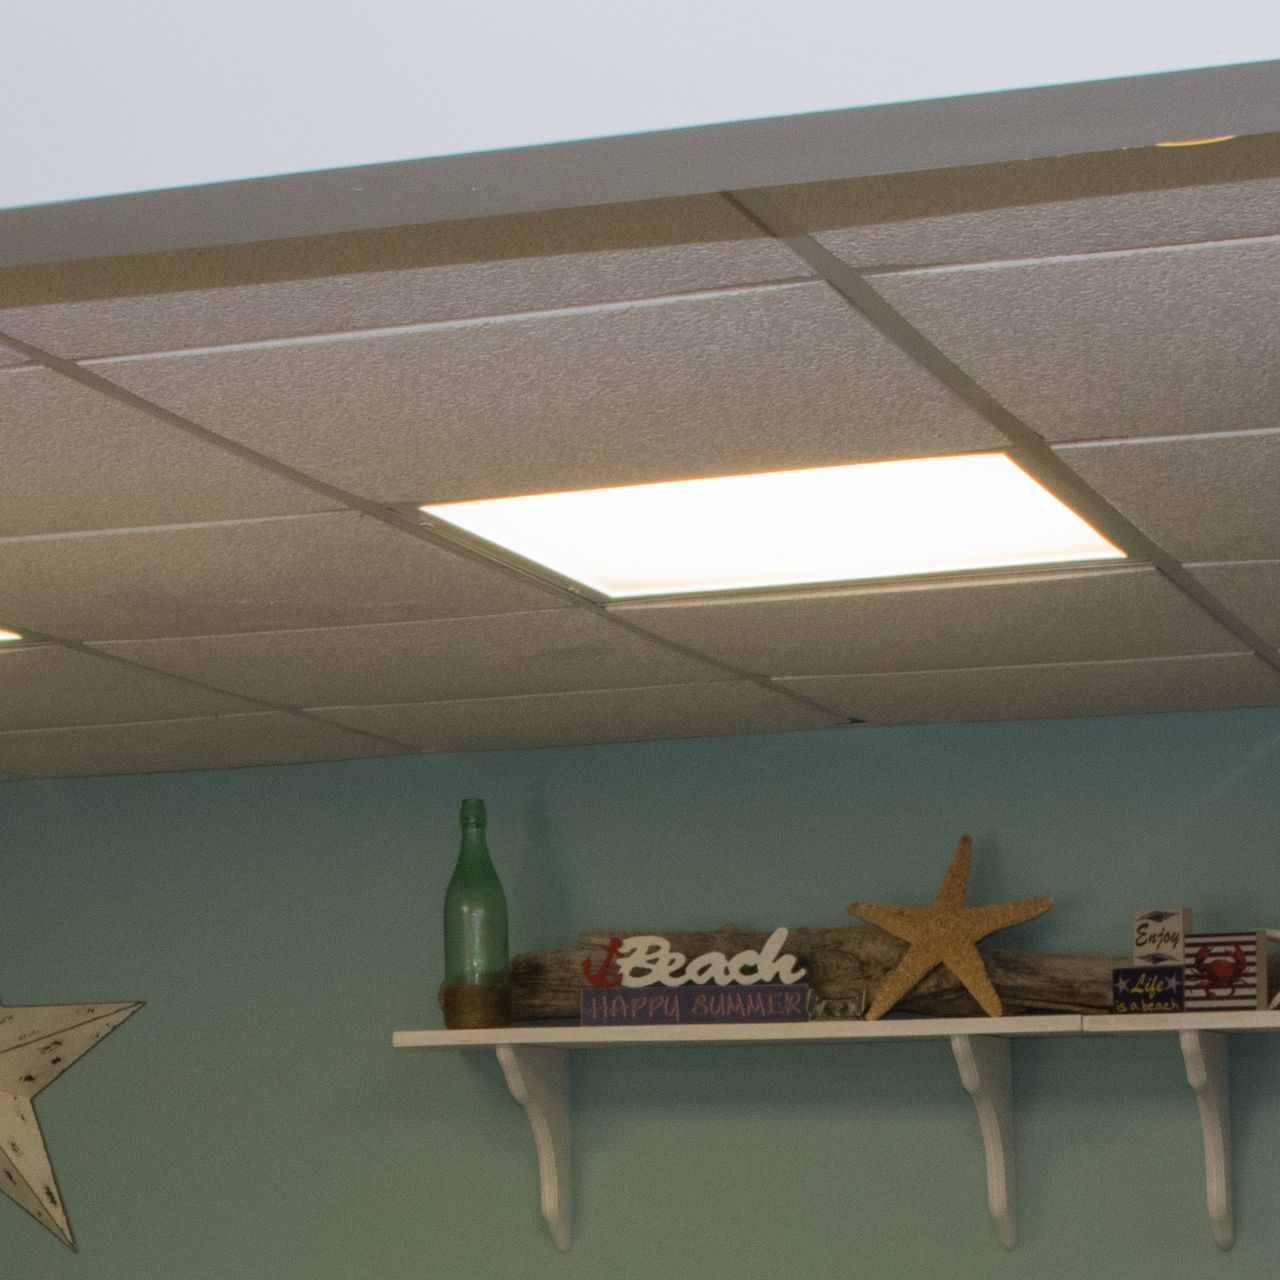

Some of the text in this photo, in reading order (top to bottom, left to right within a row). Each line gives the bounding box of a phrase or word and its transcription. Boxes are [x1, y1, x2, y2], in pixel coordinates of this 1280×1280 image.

[1135, 923, 1181, 949] Enjoy
[616, 926, 807, 989] Beach
[1131, 973, 1166, 997] Life
[591, 990, 803, 1022] HAPPY SUMMER
